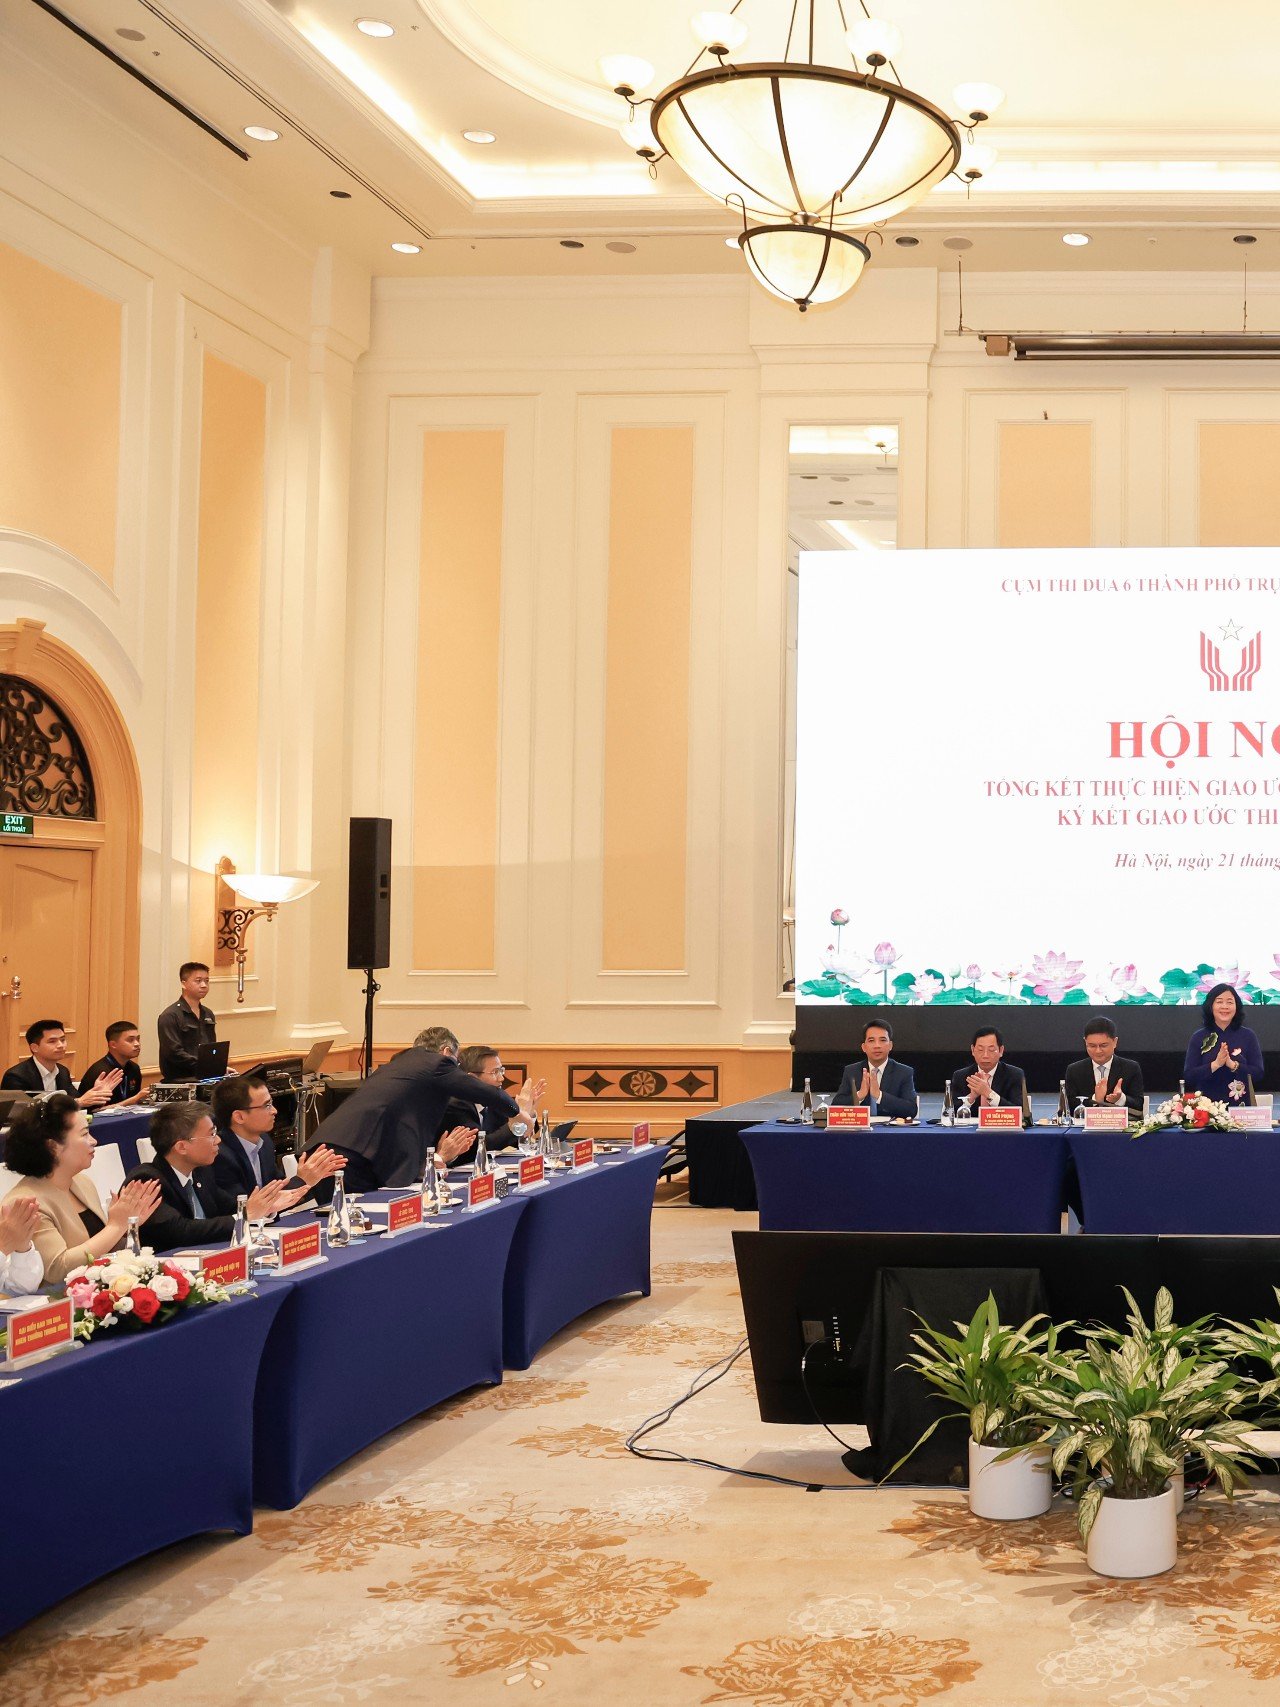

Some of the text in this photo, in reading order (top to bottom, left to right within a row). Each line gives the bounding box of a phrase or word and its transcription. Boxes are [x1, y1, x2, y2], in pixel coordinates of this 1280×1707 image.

[1001, 579, 1041, 596] CỤM
[1047, 579, 1077, 592] THI
[1123, 579, 1131, 592] 6
[1136, 574, 1198, 592] THÀNH
[1106, 714, 1213, 769] HỘI
[1045, 775, 1085, 797] KẾT
[1090, 777, 1146, 801] THỰC
[1152, 777, 1201, 801] HIỆN
[1206, 780, 1257, 797] GIAO
[5, 815, 24, 825] EXIT
[1058, 805, 1085, 826] KÝ
[1090, 804, 1131, 826] KẾT
[1136, 809, 1188, 826] GIAO
[1193, 804, 1237, 825] ƯỚC
[1244, 808, 1279, 825] THI
[1115, 852, 1137, 868] Hà
[1177, 854, 1214, 872] ngày
[1217, 853, 1235, 868] 21
